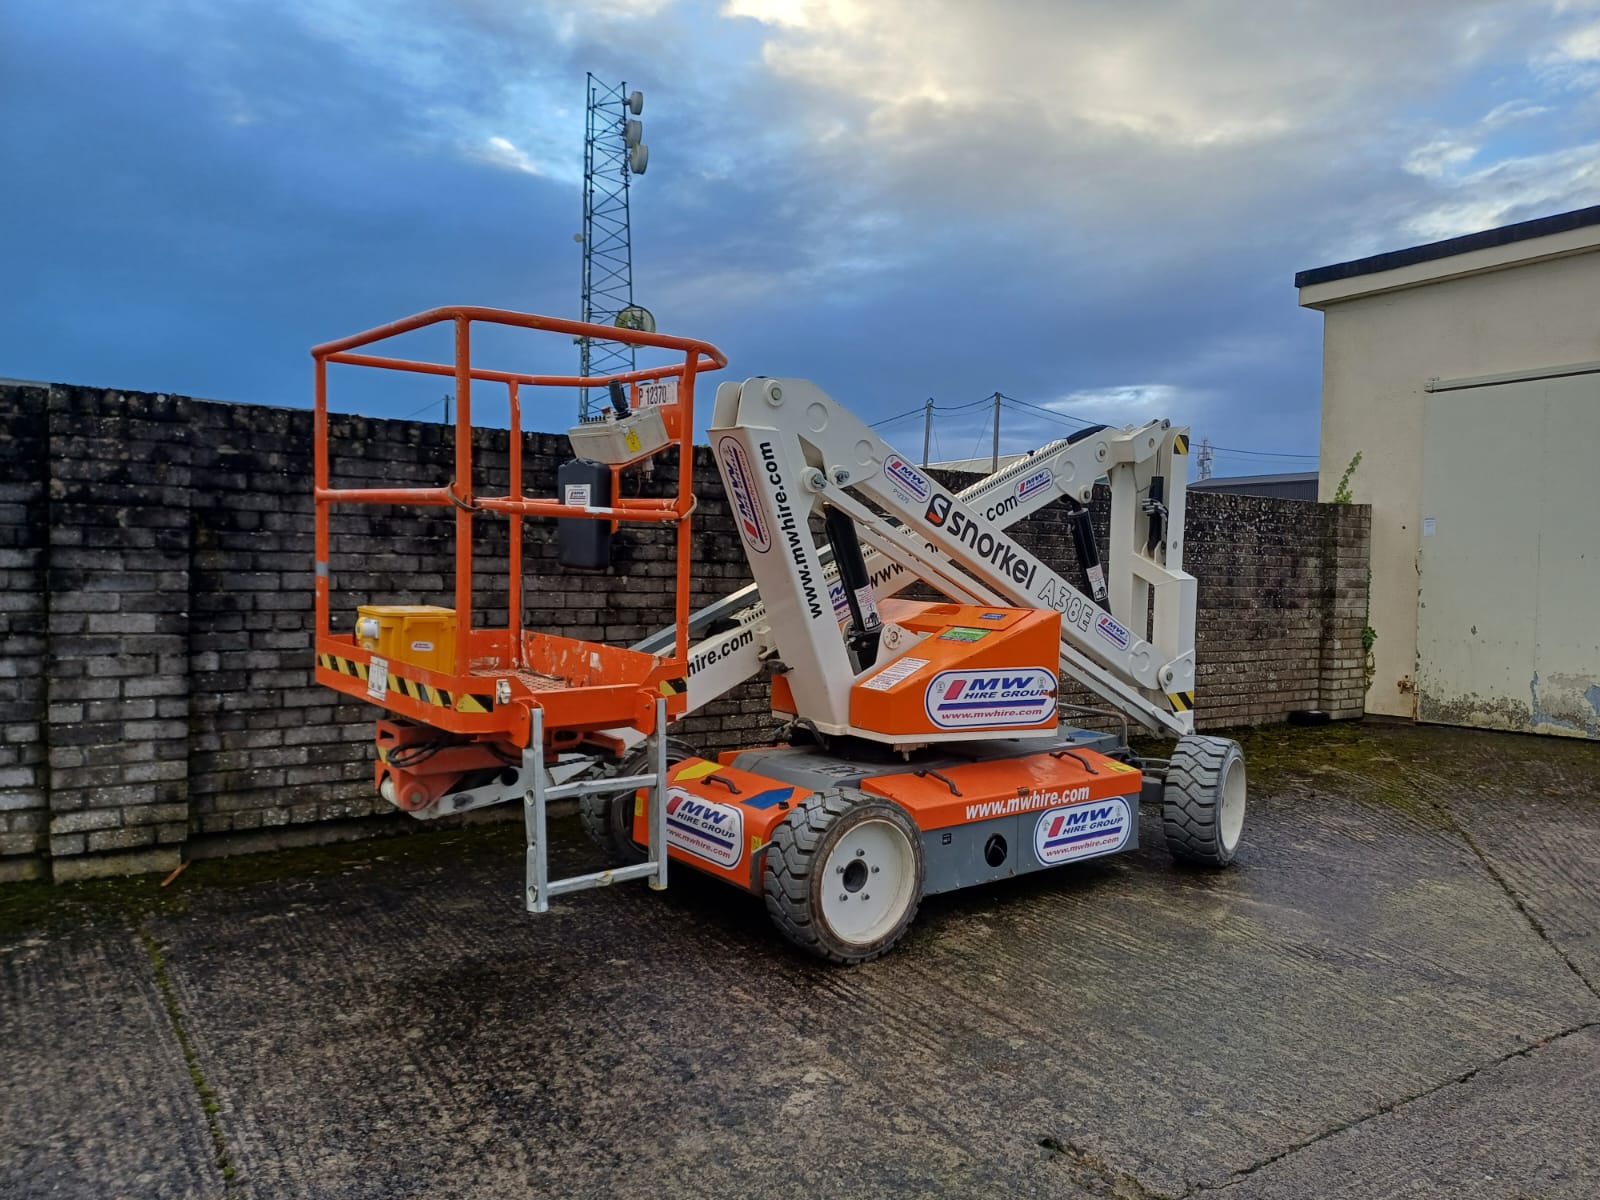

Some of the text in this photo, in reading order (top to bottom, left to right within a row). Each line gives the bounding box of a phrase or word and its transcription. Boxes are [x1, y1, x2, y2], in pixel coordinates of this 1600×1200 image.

[646, 385, 667, 405] 12370
[901, 466, 925, 485] MW
[1025, 471, 1045, 486] MW
[725, 459, 748, 518] MW
[759, 441, 823, 620] www.mwhire.com
[946, 511, 1038, 590] snorkel
[1038, 578, 1094, 633] A38E
[968, 676, 1035, 691] MW
[963, 689, 1049, 700] HIRE GROUP
[941, 706, 1043, 720] www.mwhire.com
[681, 800, 729, 825] MW
[965, 786, 1090, 820] www.mwhire.com
[676, 812, 736, 839] HIRE GROUP
[1062, 816, 1124, 836] HIRE GROUP
[1066, 806, 1114, 826] MW
[1045, 836, 1120, 857] www.mwhire.com
